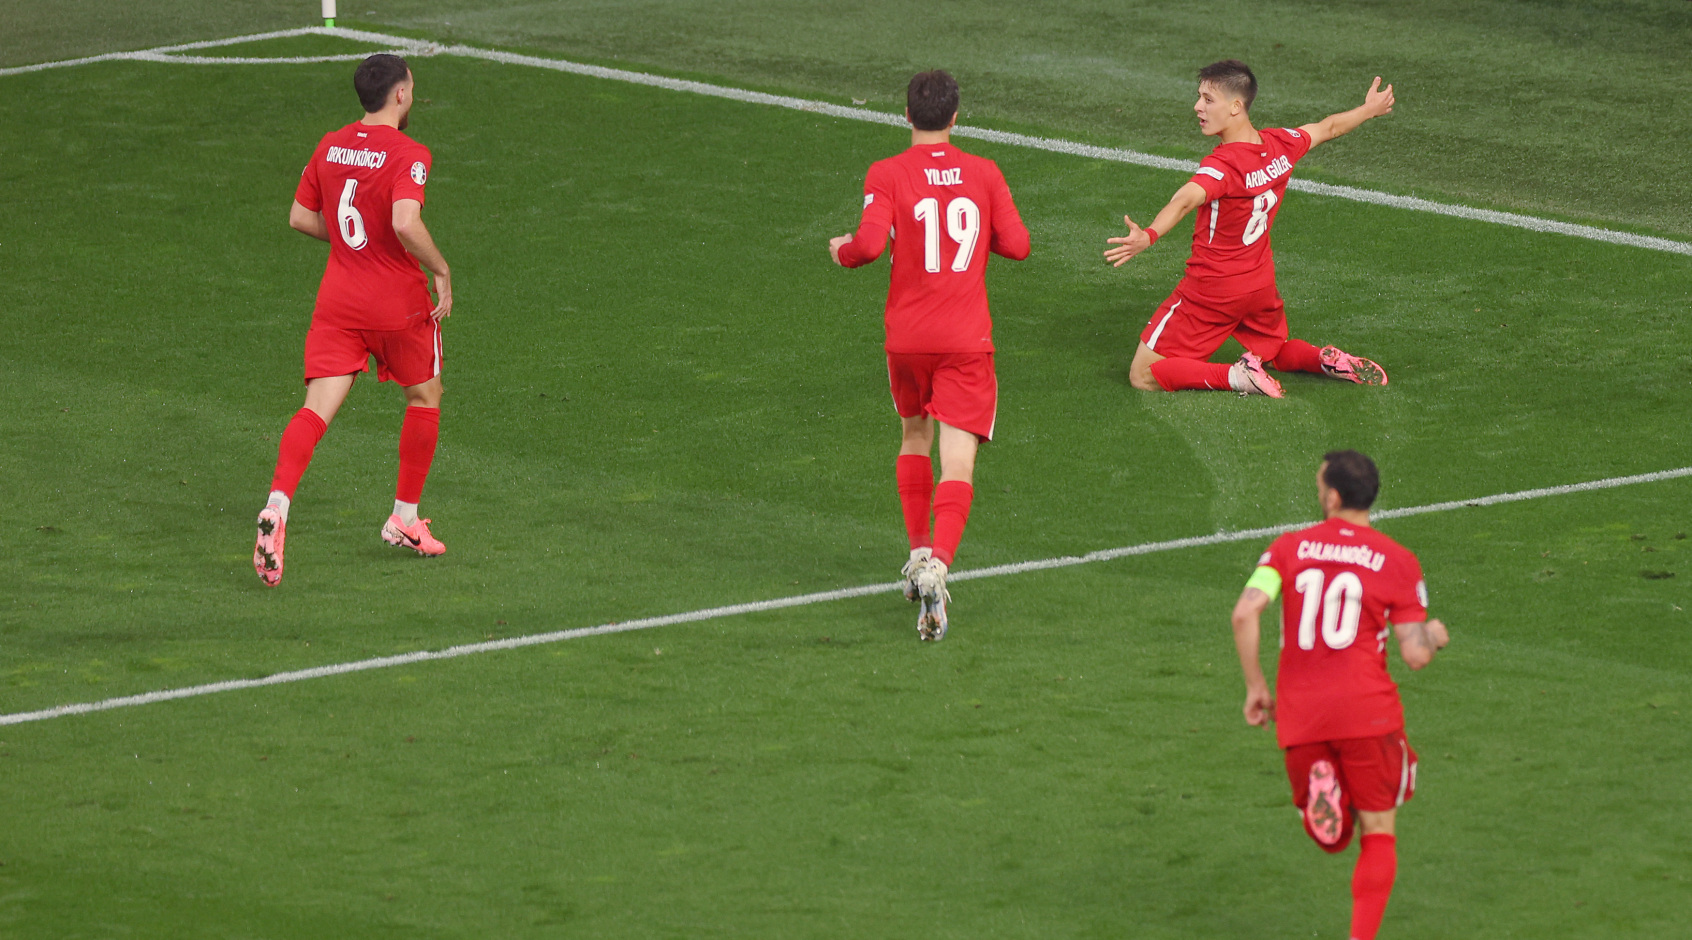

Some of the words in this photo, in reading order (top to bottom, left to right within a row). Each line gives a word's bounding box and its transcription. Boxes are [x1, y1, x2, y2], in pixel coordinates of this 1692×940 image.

[337, 178, 368, 251] 6
[914, 196, 981, 273] 19
[1242, 188, 1278, 246] 8
[1295, 567, 1363, 651] 10
